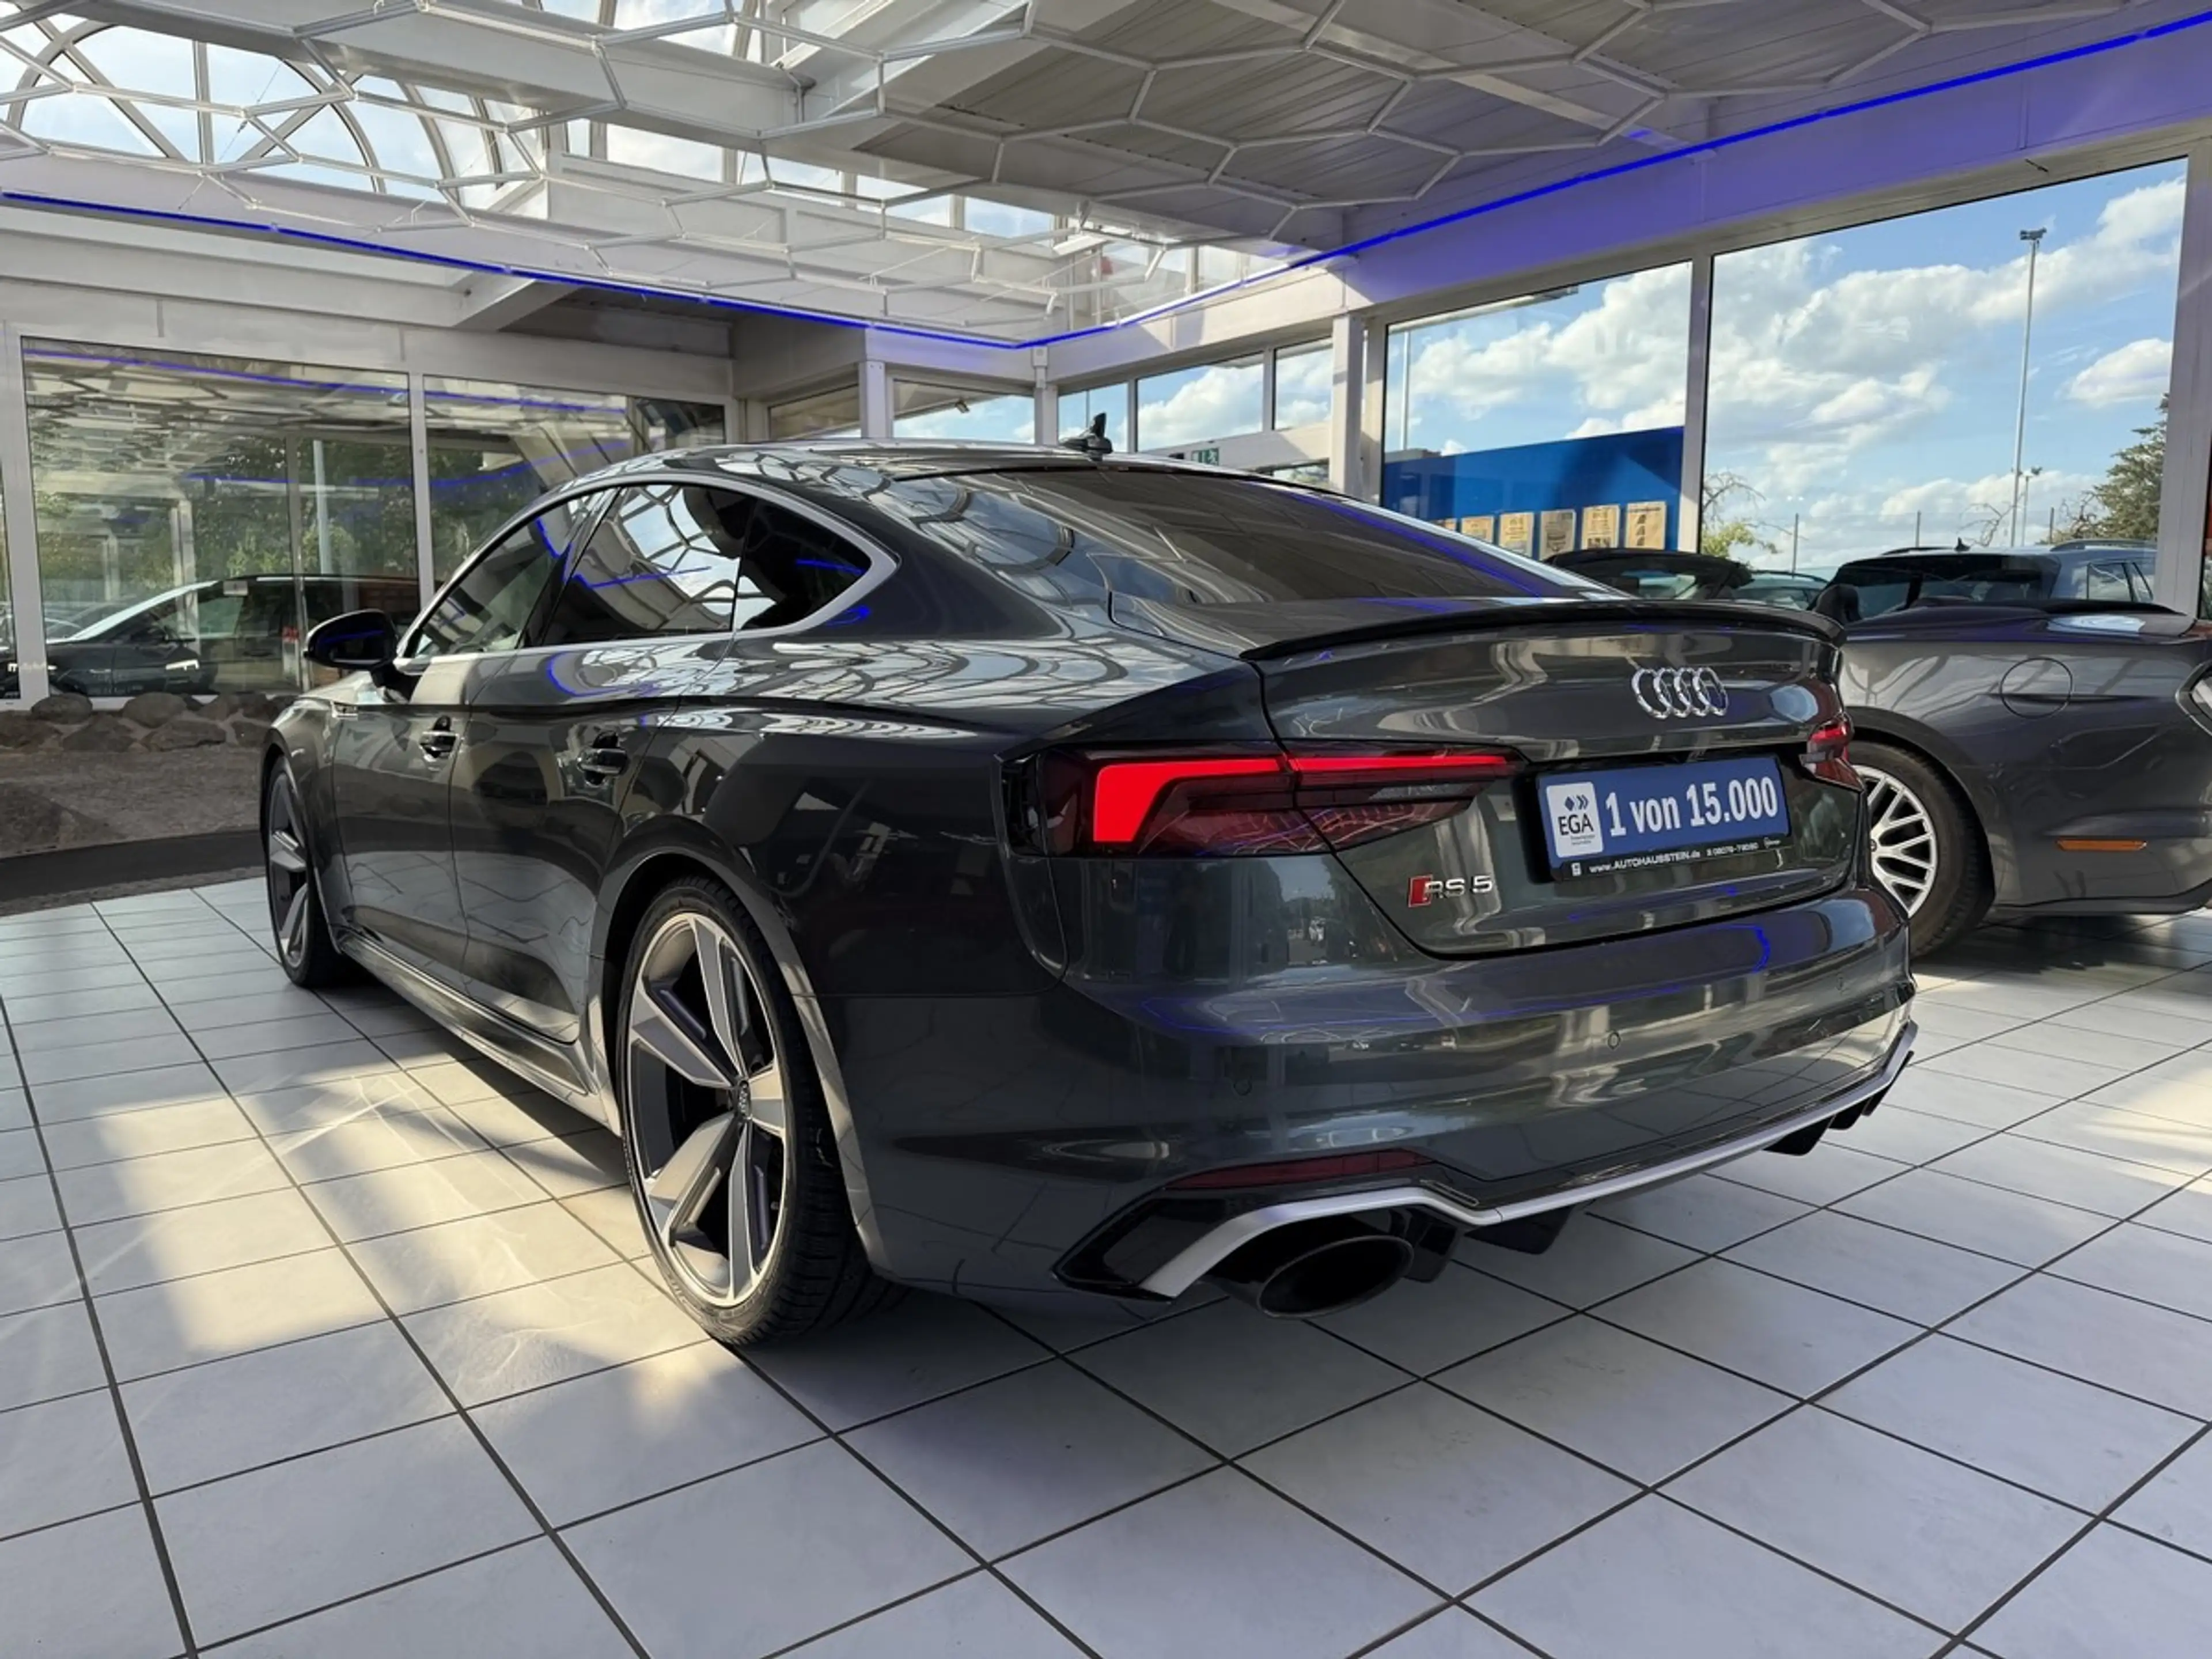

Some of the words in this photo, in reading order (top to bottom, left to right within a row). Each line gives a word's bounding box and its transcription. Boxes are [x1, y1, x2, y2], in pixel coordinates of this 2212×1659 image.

[1557, 813, 1594, 836] EGA
[1605, 791, 1627, 837] 1
[1629, 795, 1681, 834] von
[1685, 775, 1778, 827] 15.000
